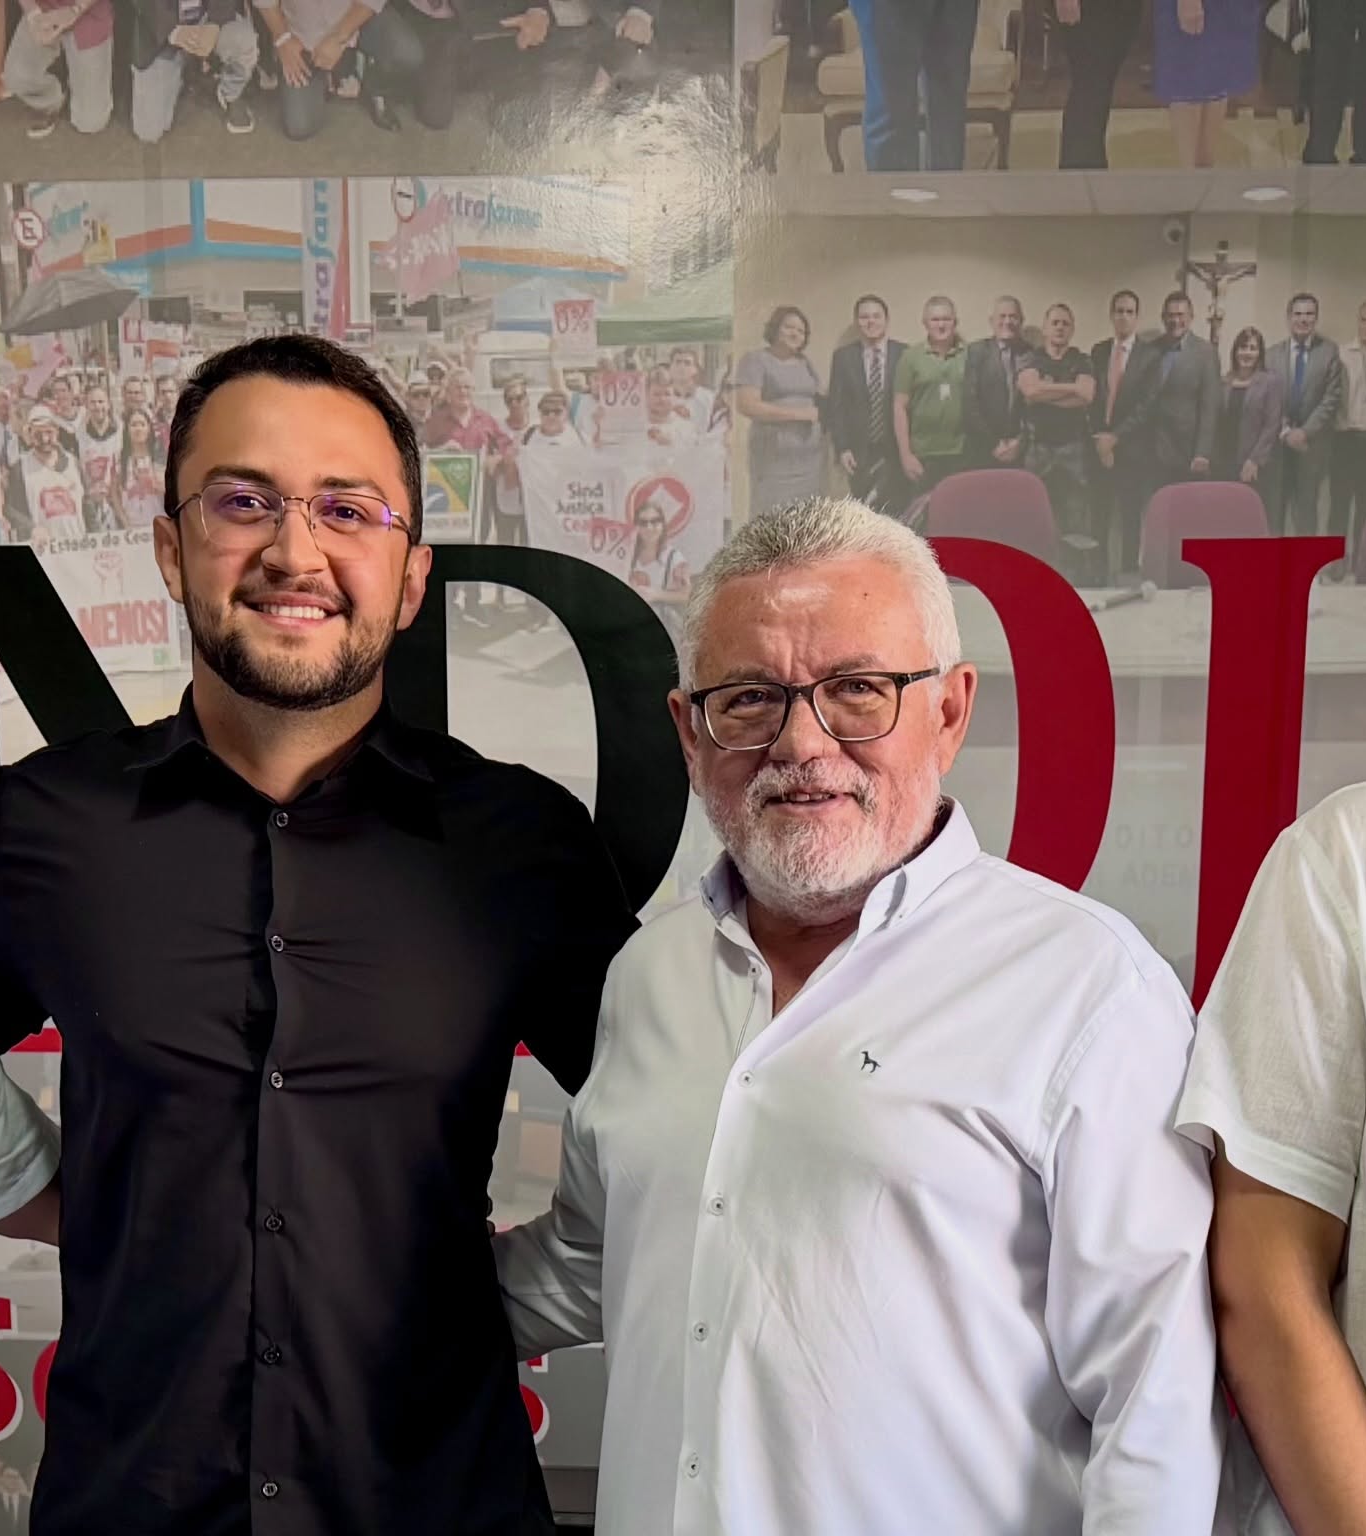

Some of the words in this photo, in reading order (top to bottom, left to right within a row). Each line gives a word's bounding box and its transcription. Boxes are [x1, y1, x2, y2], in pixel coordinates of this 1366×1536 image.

[604, 379, 640, 406] 0%
[566, 481, 604, 499] Sind
[555, 498, 604, 514] Justiça
[50, 534, 97, 554] Estado
[101, 529, 120, 548] do
[590, 525, 626, 560] 0%
